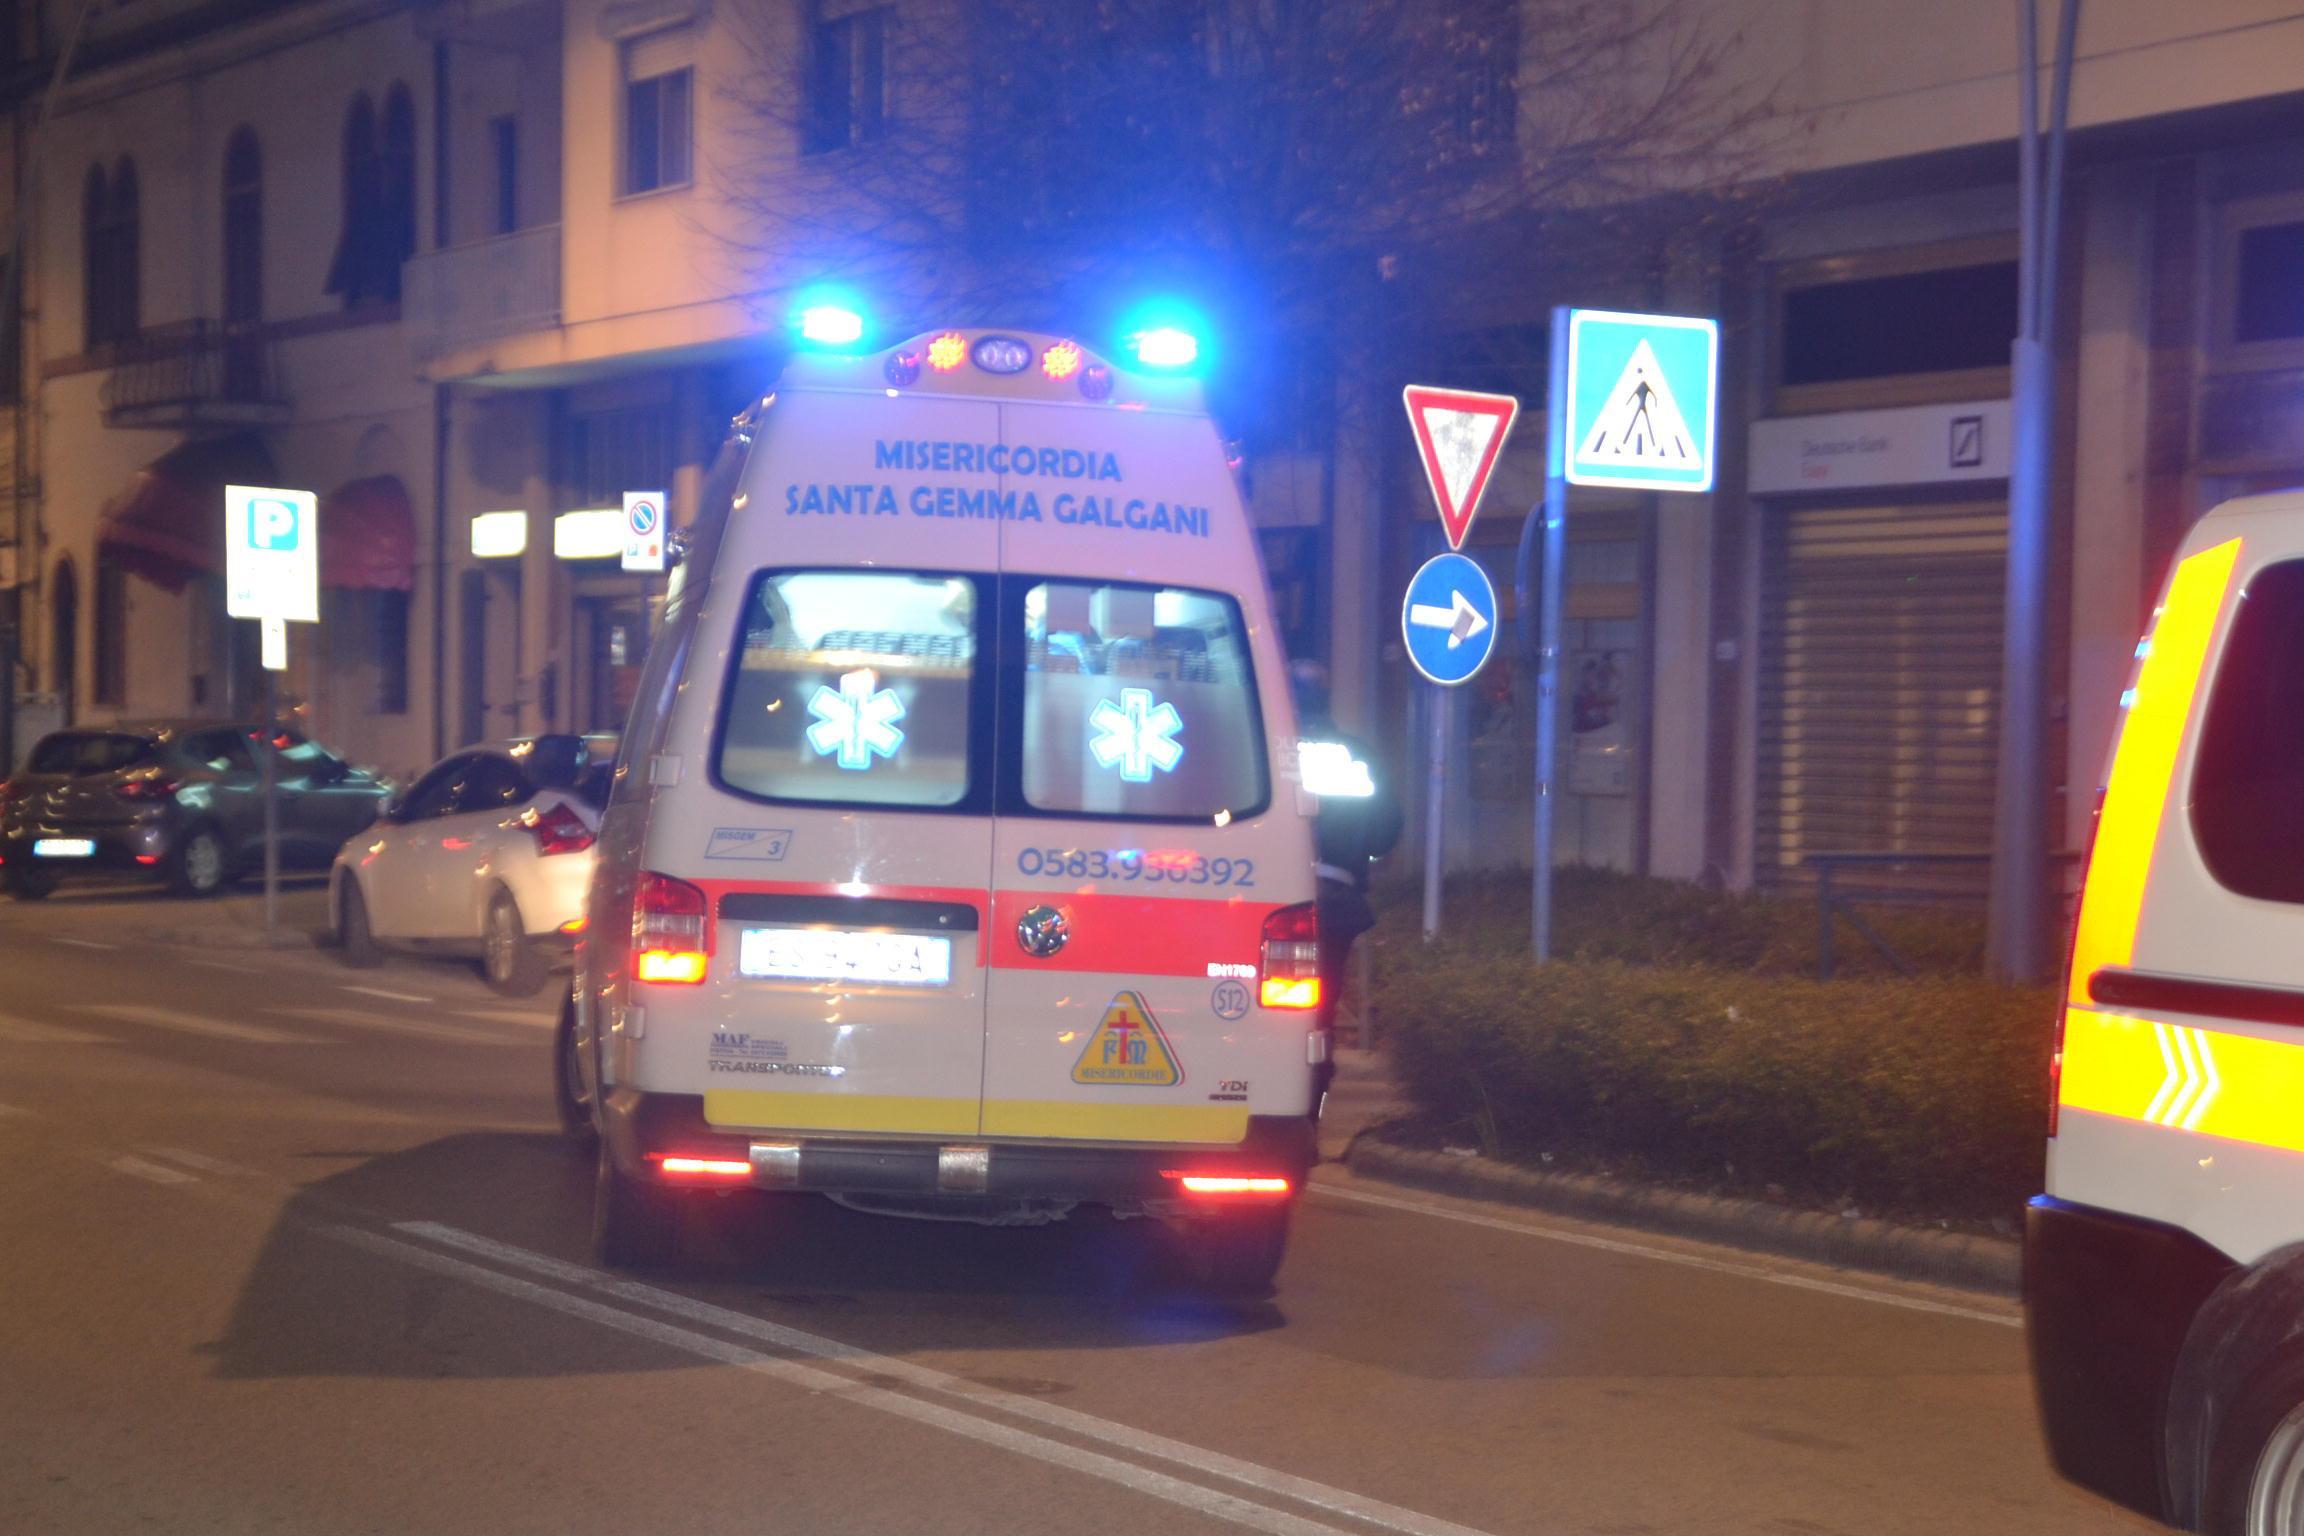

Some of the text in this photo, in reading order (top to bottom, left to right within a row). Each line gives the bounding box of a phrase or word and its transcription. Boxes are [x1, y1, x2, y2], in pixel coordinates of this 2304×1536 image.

[874, 439, 1123, 483] MISERICORDIA
[254, 501, 293, 548] P
[785, 483, 1210, 538] SANTA GEMMA GALGANI
[767, 840, 781, 856] 3
